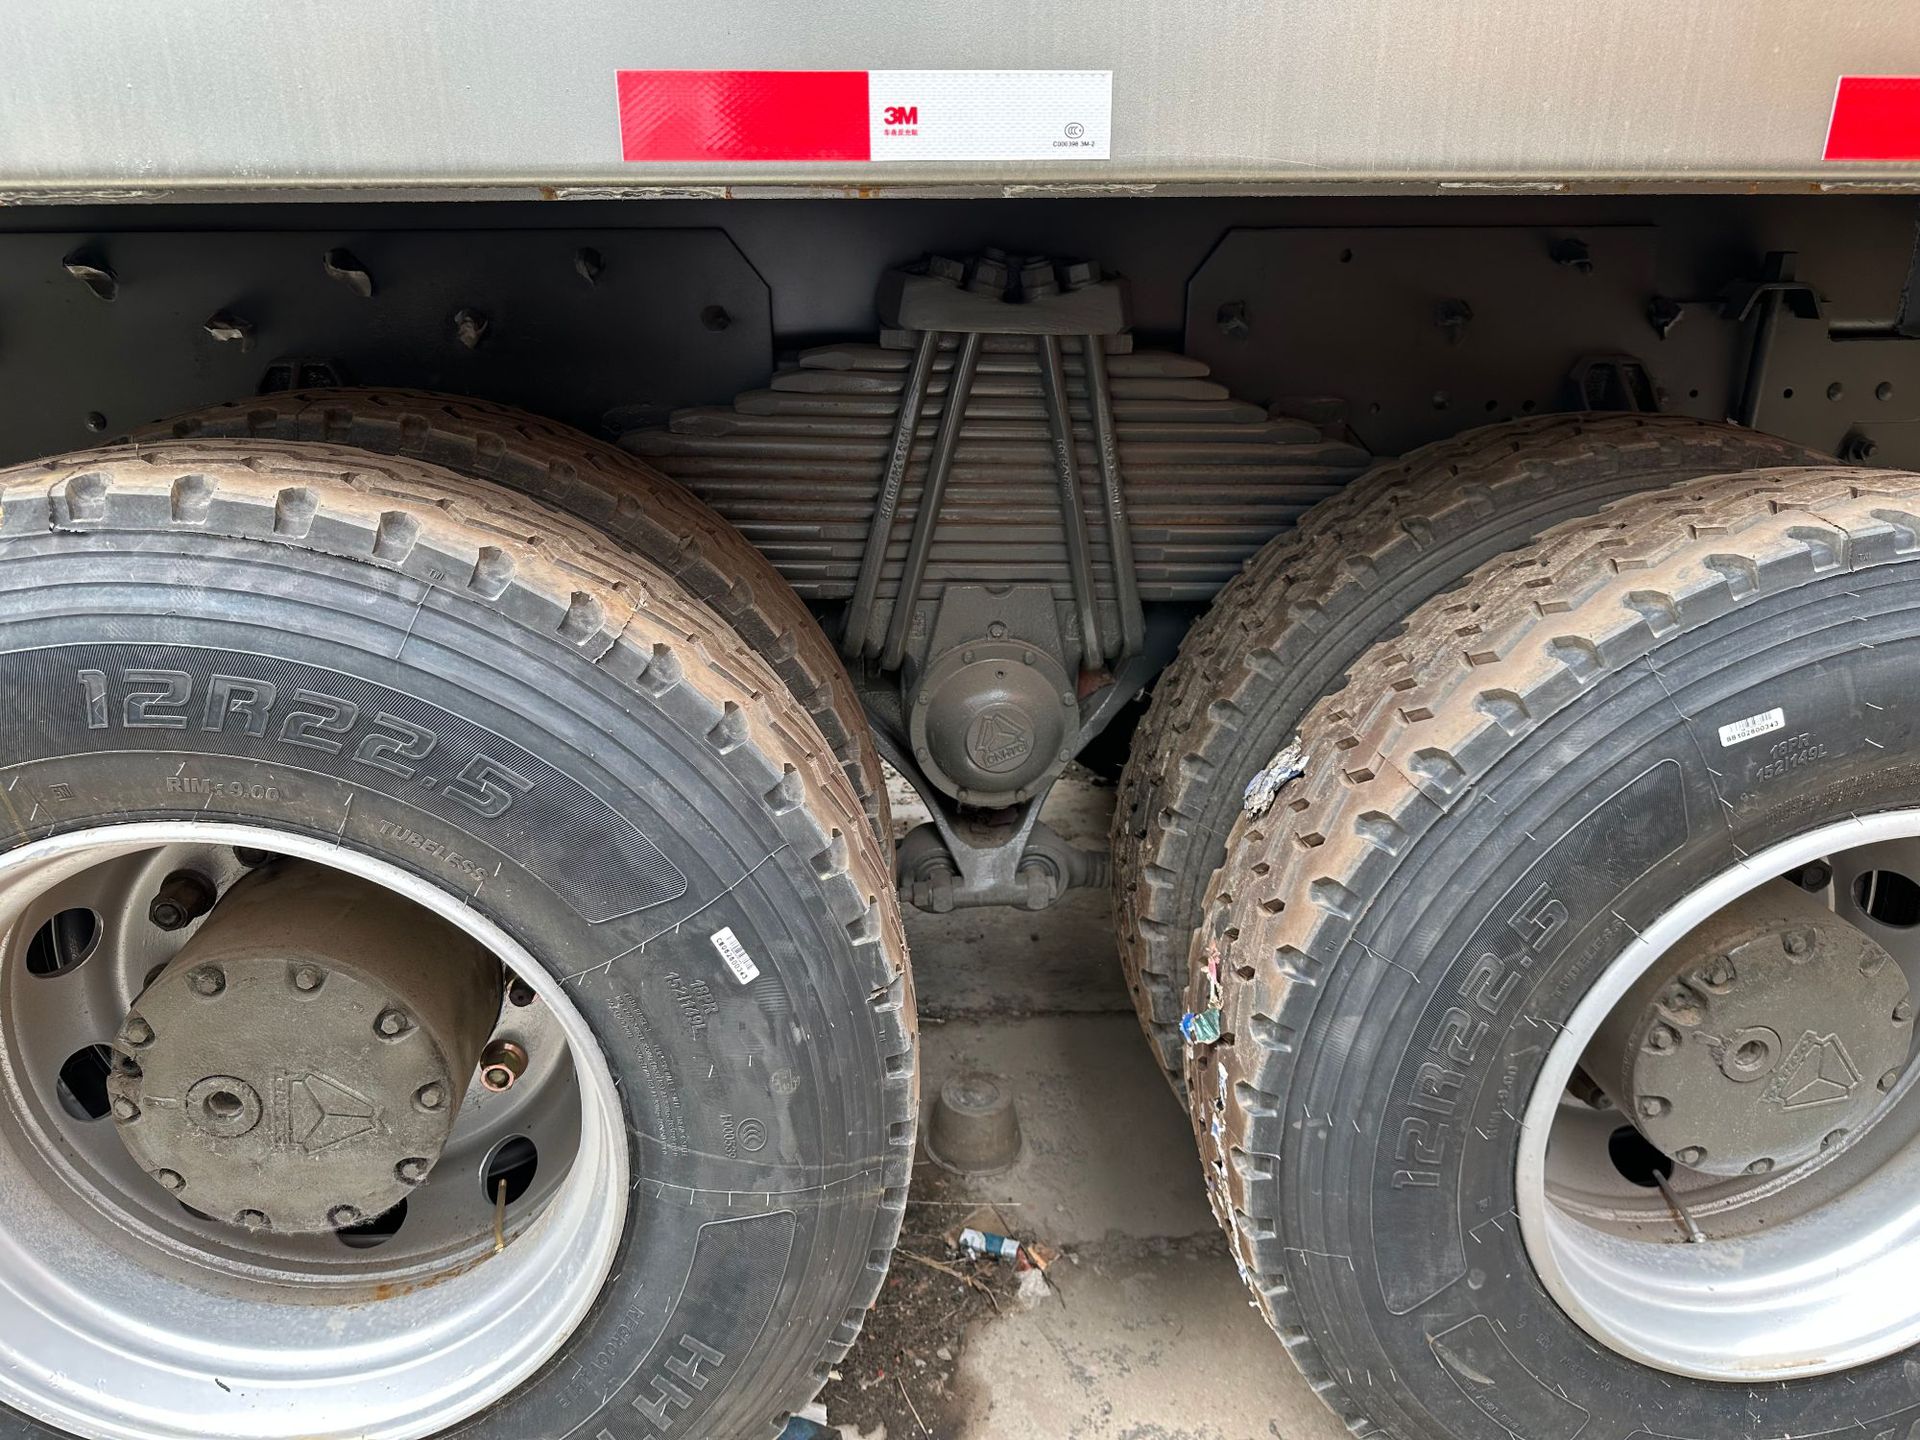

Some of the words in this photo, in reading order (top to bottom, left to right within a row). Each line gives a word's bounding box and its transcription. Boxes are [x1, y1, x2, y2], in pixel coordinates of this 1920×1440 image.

[884, 106, 918, 125] 3M
[78, 668, 536, 820] 12R22.5
[379, 818, 489, 884] TUBELESS
[1393, 881, 1574, 1190] 12R22.5
